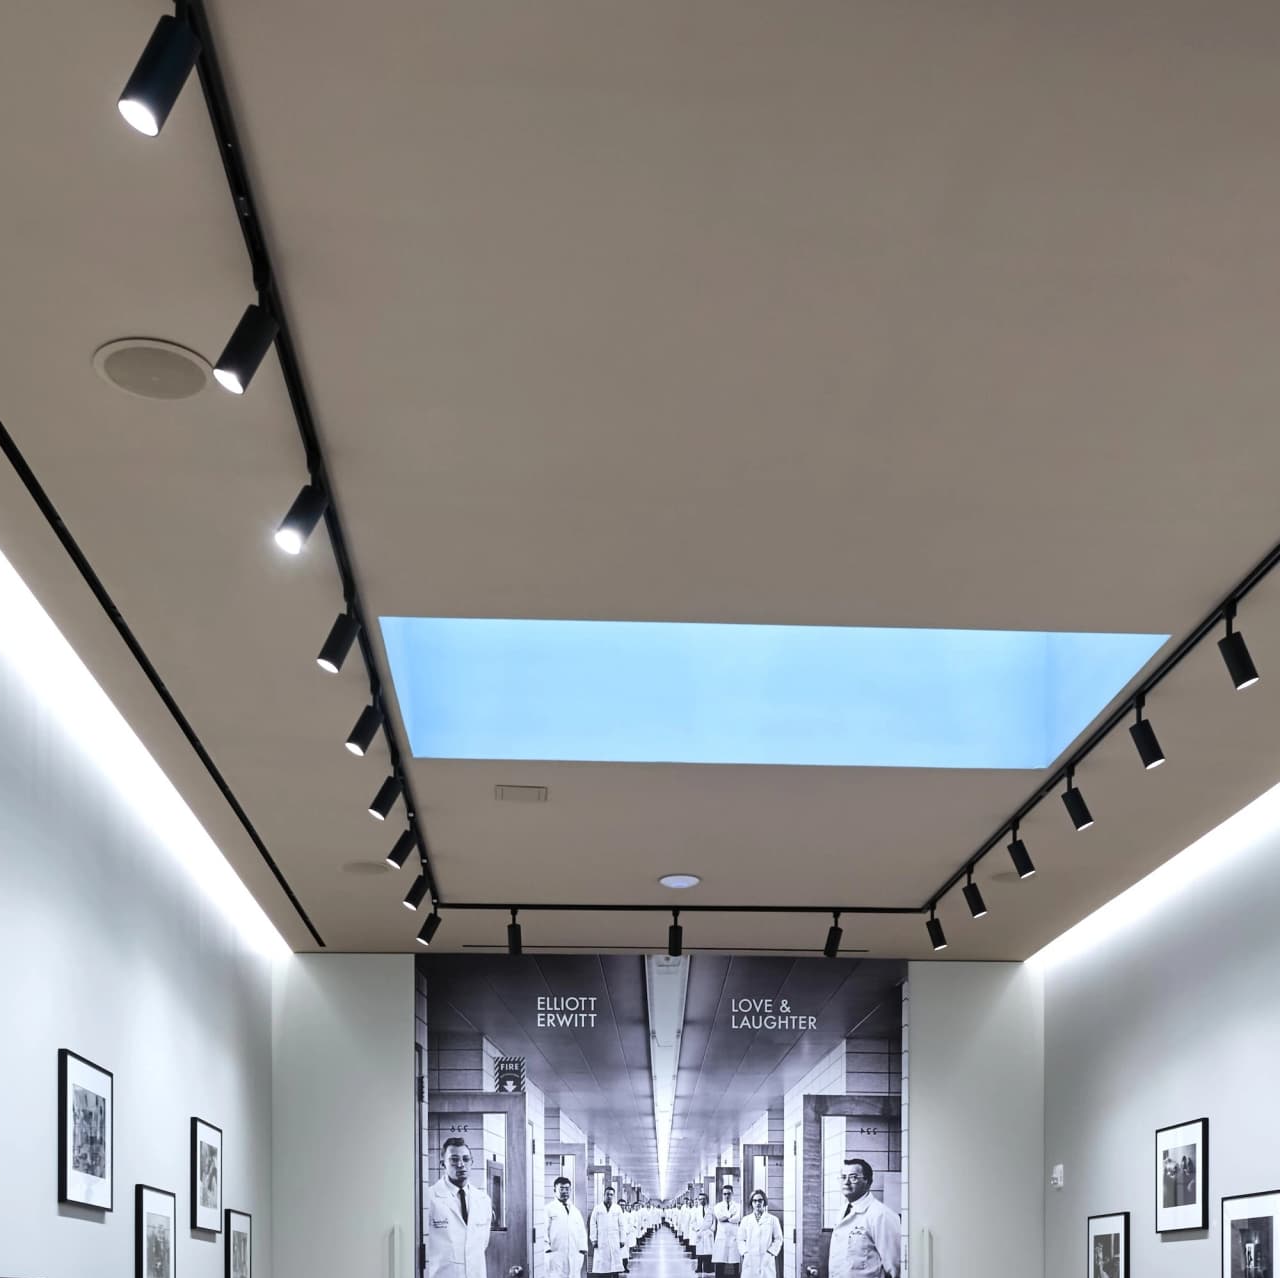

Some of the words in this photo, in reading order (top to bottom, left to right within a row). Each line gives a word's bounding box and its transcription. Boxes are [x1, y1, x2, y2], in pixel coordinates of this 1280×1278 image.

[537, 996, 597, 1011] ELLIOTT
[731, 998, 773, 1013] LOVE
[779, 999, 792, 1013] &
[537, 1013, 597, 1028] ERWITT
[731, 1015, 817, 1030] LAUGHTER
[500, 1063, 520, 1071] FIRE
